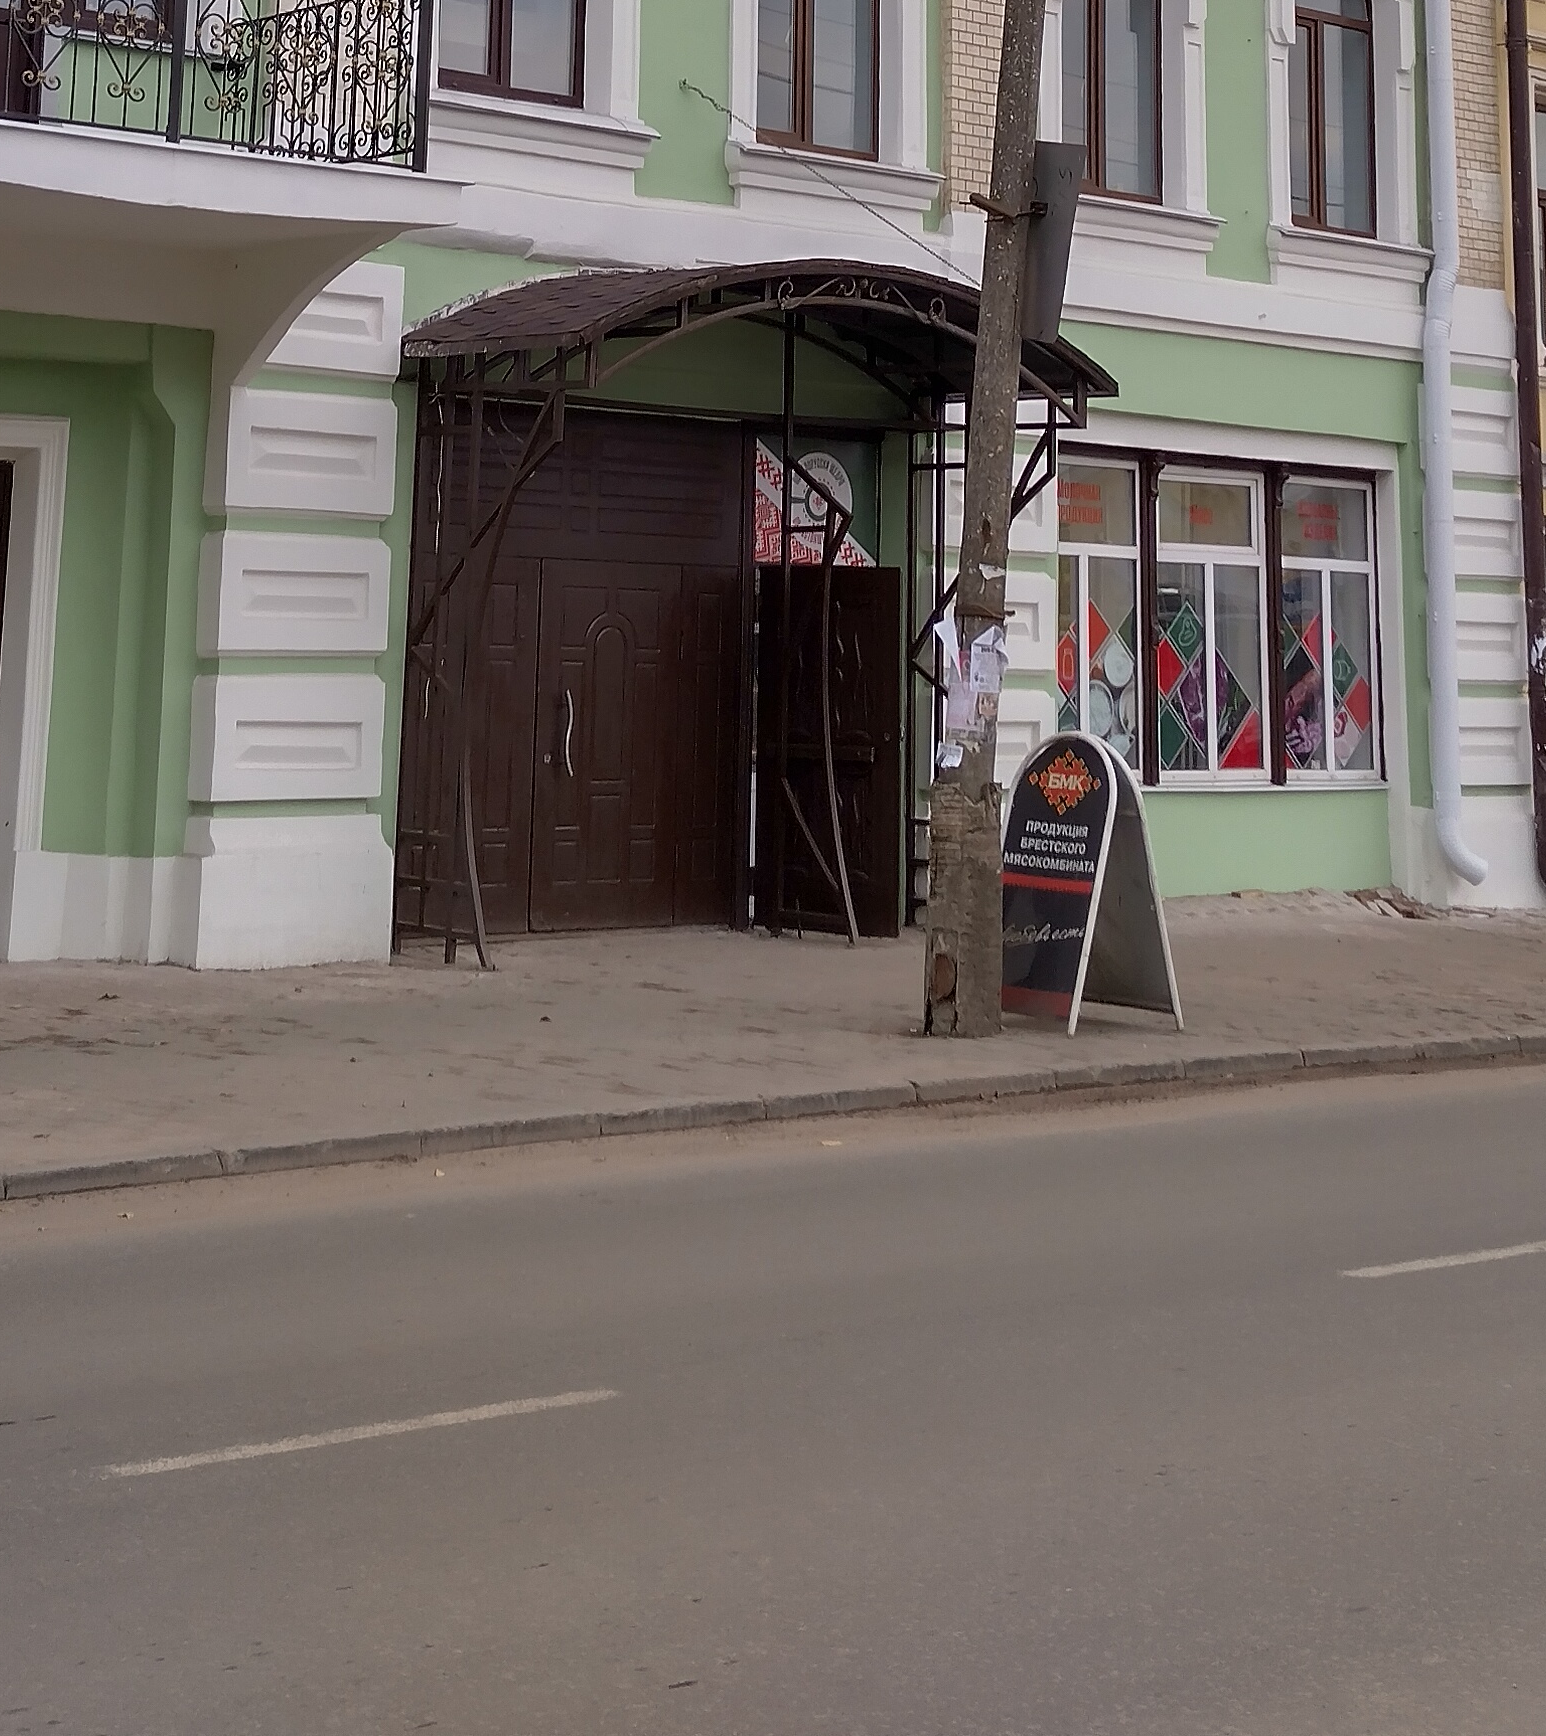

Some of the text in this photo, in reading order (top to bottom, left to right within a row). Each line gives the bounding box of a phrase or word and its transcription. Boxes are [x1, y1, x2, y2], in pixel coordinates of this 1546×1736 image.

[1047, 772, 1086, 791] БМК
[1026, 820, 1089, 839] ПРОДУКЦИЯ
[1020, 837, 1086, 855] БРЕСТСКОГО
[1003, 850, 1095, 874] МЯСОКОМБИНАТА
